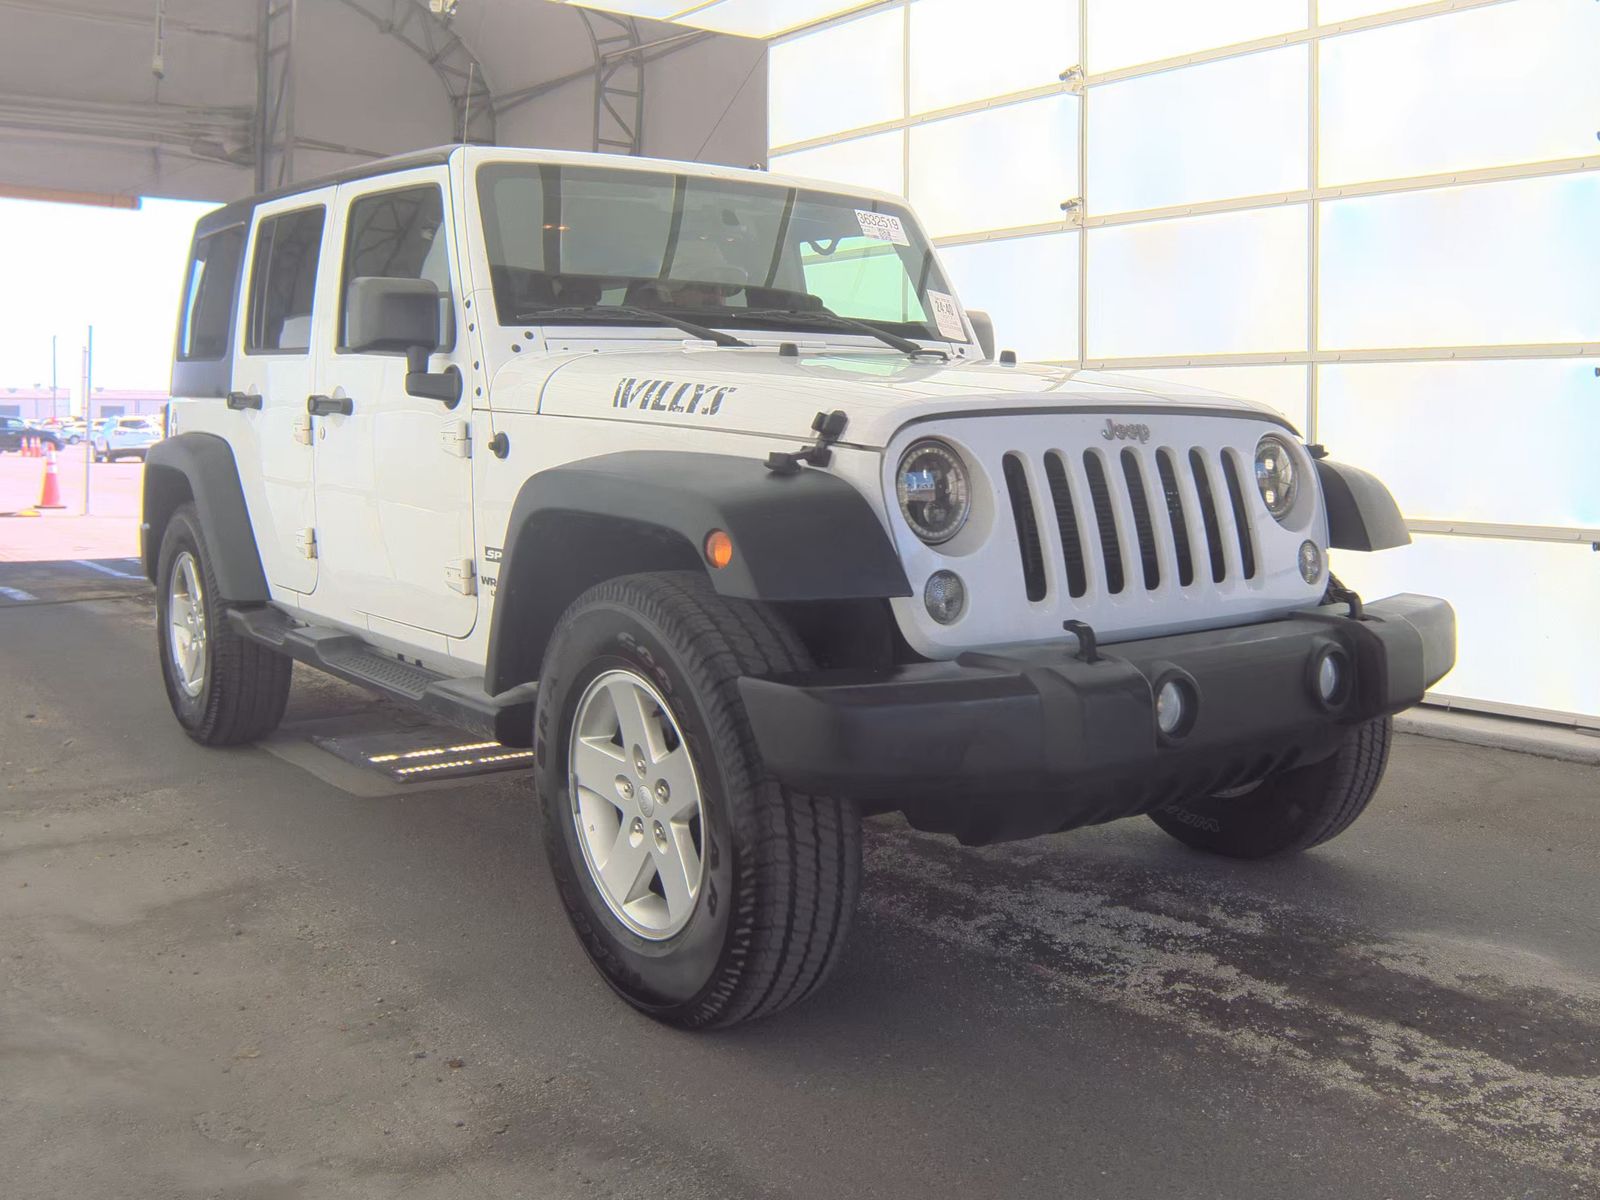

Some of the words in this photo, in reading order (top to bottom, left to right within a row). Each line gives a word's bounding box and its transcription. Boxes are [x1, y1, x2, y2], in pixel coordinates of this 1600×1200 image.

[856, 211, 900, 230] 3632519
[612, 377, 738, 415] WILLYS
[1101, 418, 1151, 445] Jeep
